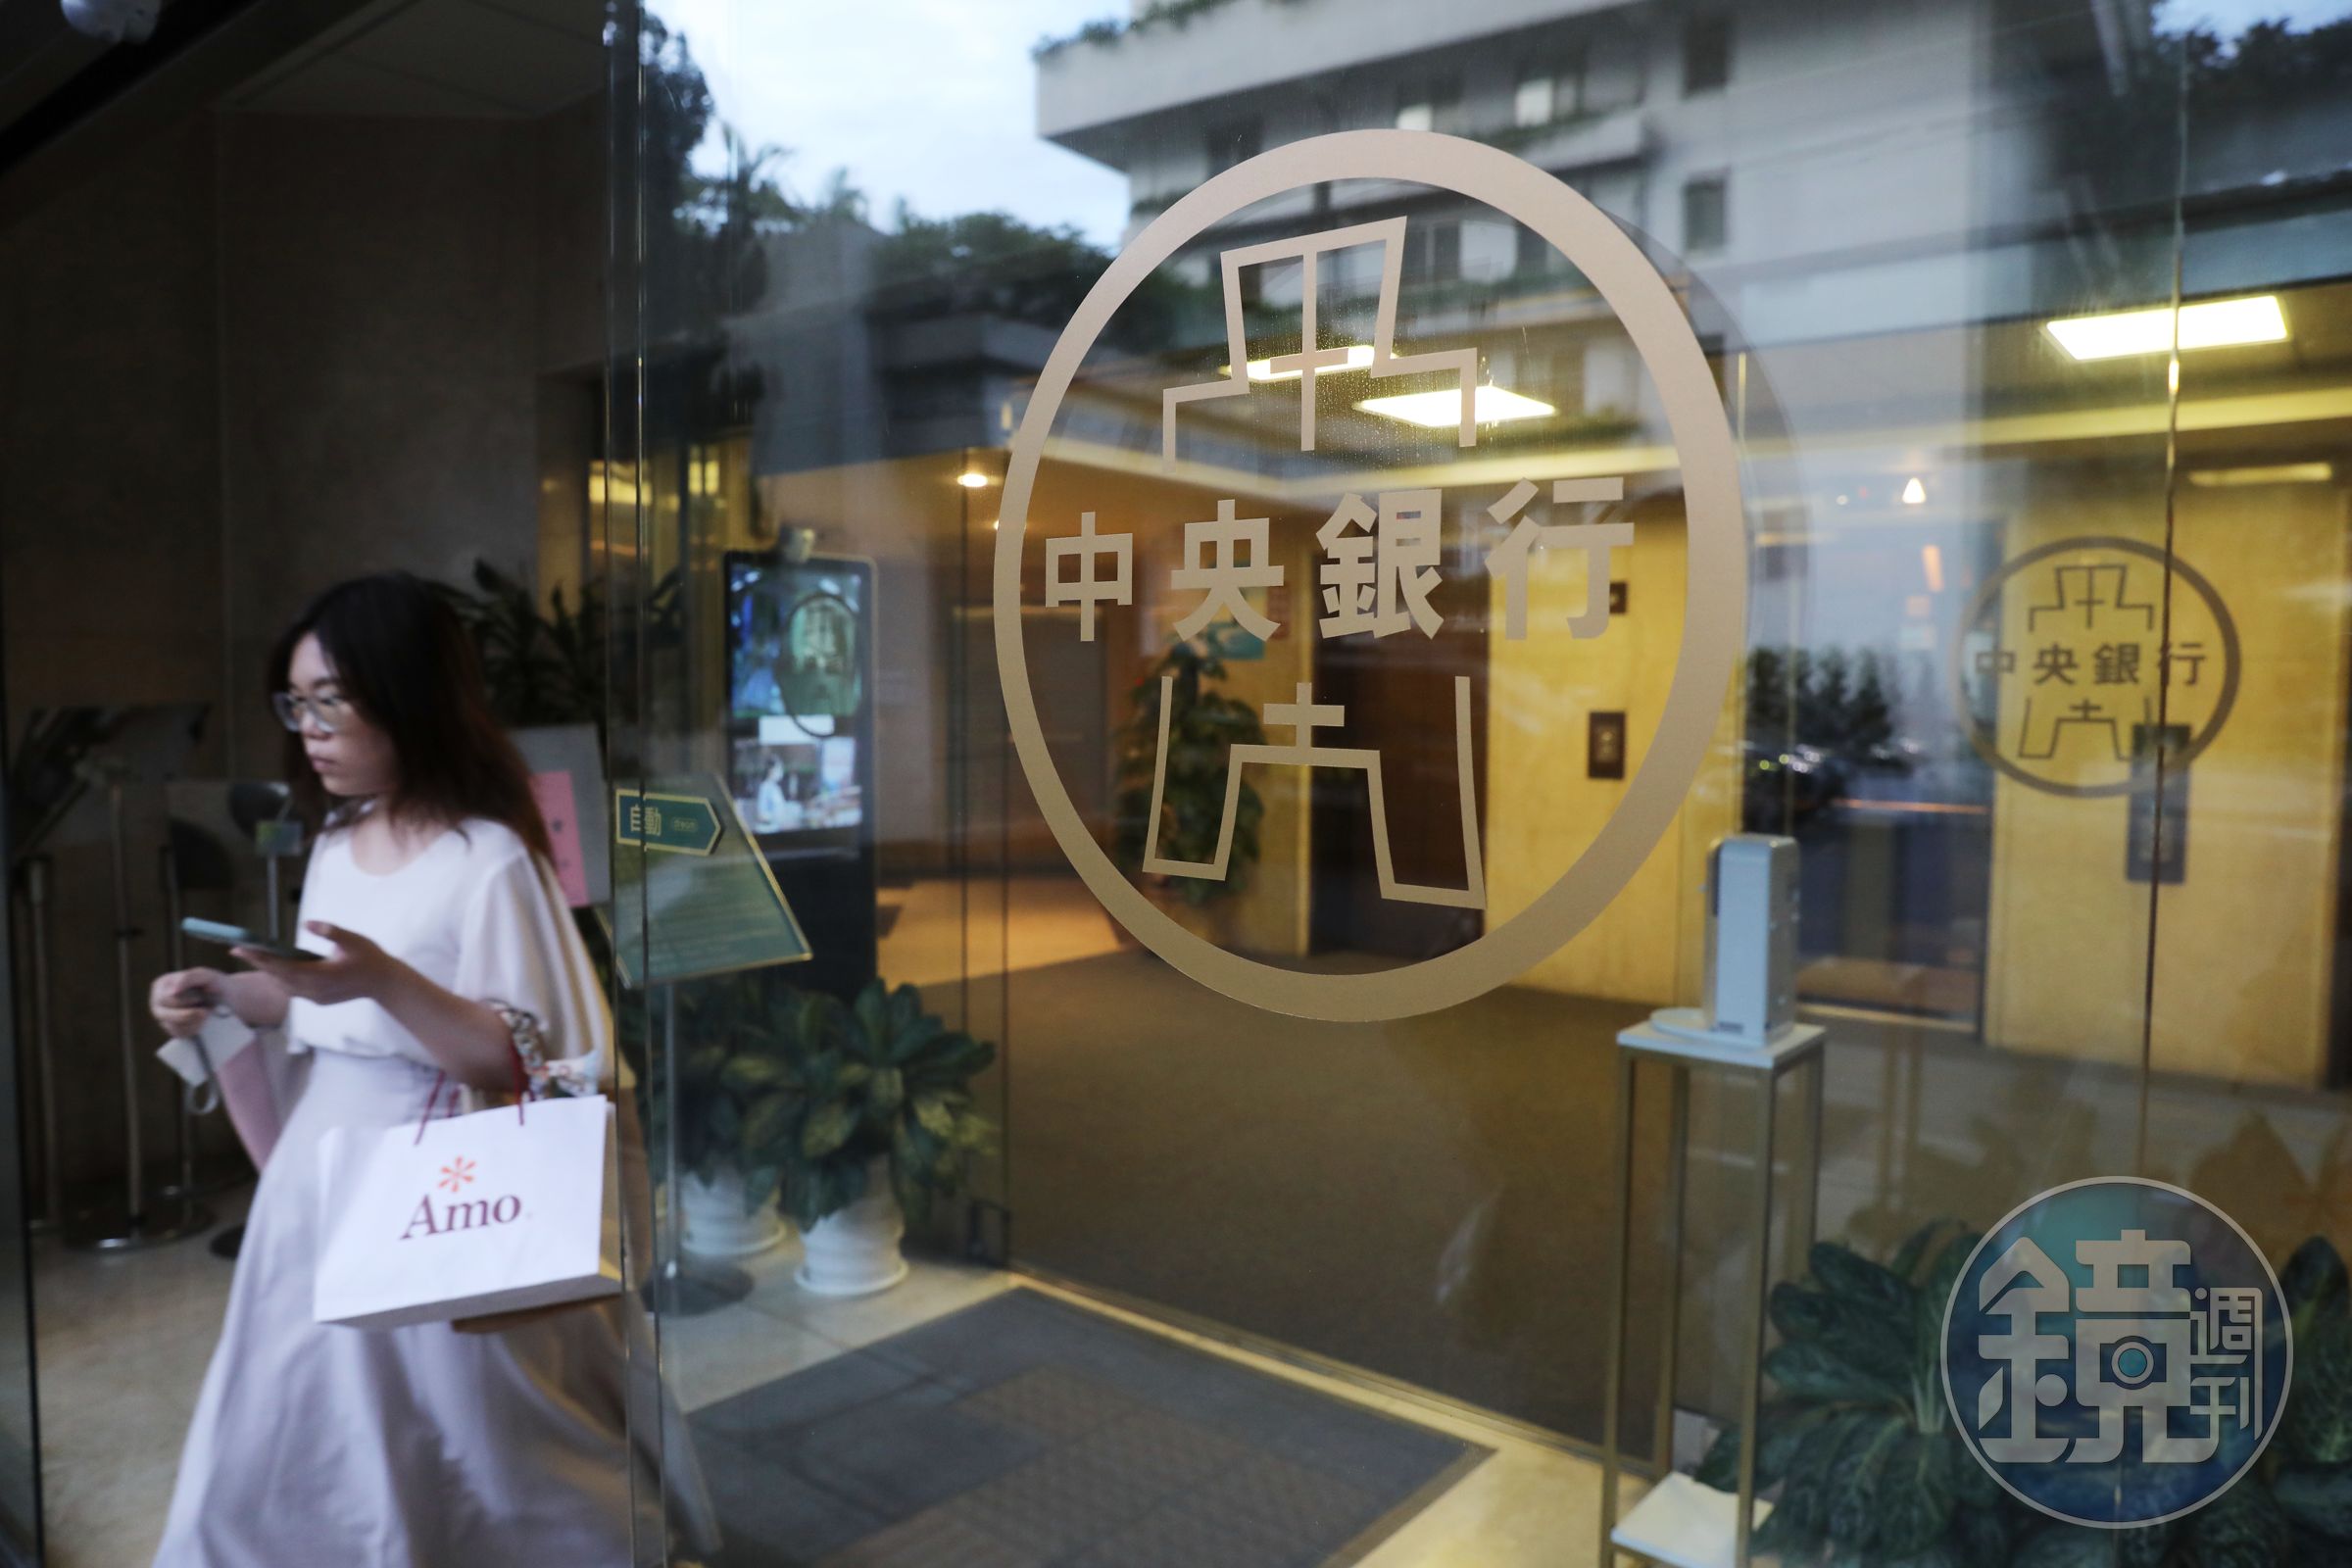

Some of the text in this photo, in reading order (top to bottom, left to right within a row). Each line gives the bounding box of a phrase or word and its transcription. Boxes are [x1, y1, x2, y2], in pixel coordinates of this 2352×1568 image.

[1045, 476, 1635, 642] 中央銀行
[1975, 642, 2206, 685] 中央銀行
[399, 1193, 522, 1241] Amo
